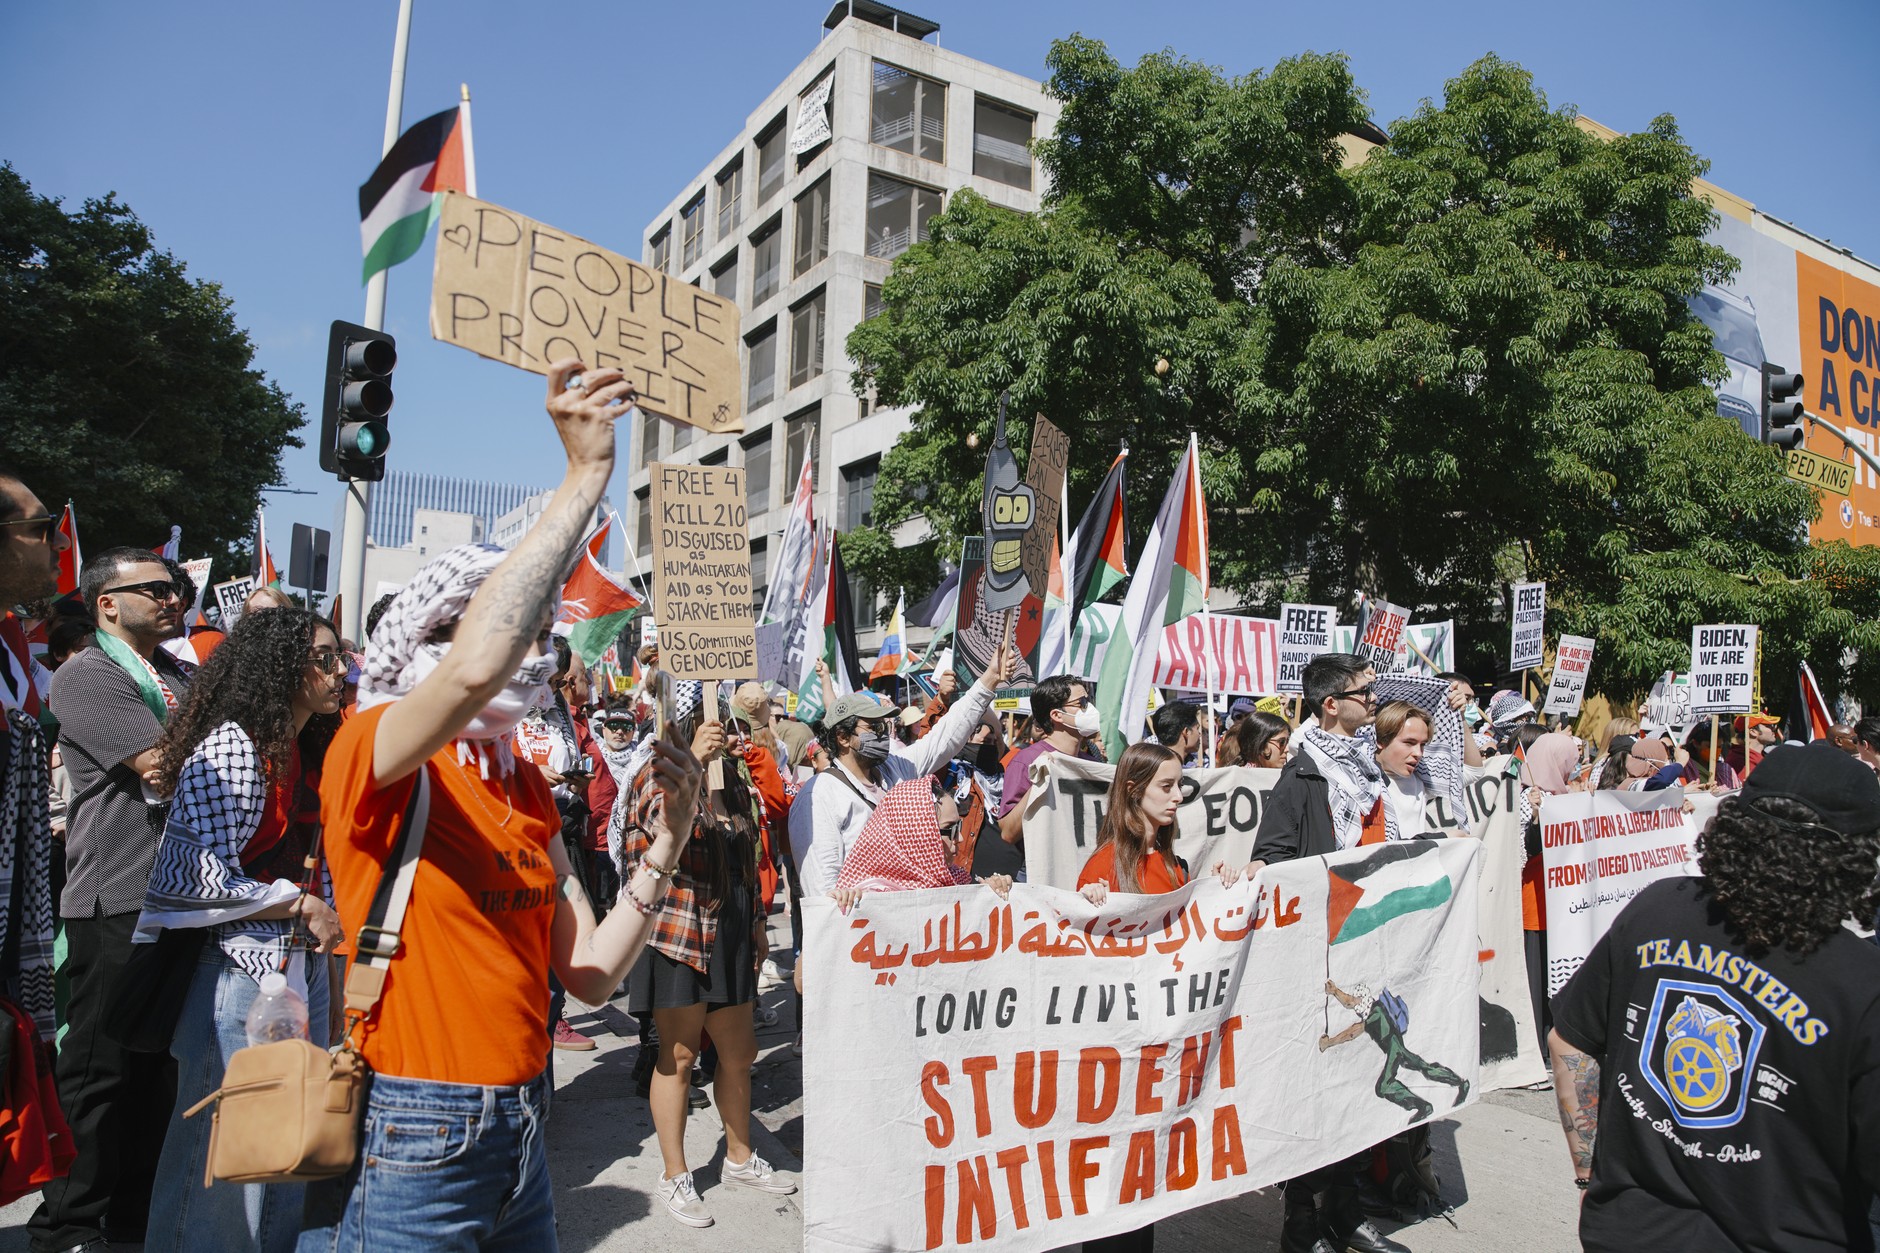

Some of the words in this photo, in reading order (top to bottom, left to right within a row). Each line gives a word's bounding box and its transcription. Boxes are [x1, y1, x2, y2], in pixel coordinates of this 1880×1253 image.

[474, 208, 725, 346] PEOPLE
[530, 285, 706, 378] OVER
[1819, 357, 1842, 417] A
[661, 468, 715, 496] FREE
[724, 472, 739, 497] 4
[1028, 457, 1049, 490] CAN
[1788, 453, 1815, 478] PED
[1818, 462, 1849, 489] XING
[663, 501, 710, 526] KILL
[714, 503, 746, 527] 210
[1035, 488, 1058, 521] BITE
[663, 528, 746, 551] DISGUISED
[689, 550, 706, 561] as
[1024, 540, 1049, 573] METAL
[664, 560, 751, 578] HUMANITARIAN
[667, 582, 691, 597] AID
[695, 583, 713, 595] as
[1028, 569, 1047, 598] ASS
[667, 601, 720, 621] STARVE
[721, 602, 753, 619] THEM
[1518, 587, 1542, 611] FREE
[1286, 608, 1328, 633] FREE
[1371, 607, 1388, 625] END
[1388, 612, 1406, 632] THE
[1515, 609, 1542, 624] PALESTINE
[661, 631, 687, 652] U.S.
[1282, 632, 1329, 646] PALESTINE
[1363, 621, 1401, 652] SIEGE
[1515, 630, 1532, 642] HANDS
[1532, 627, 1542, 639] OFF
[1699, 629, 1749, 649] BIDEN,
[1281, 651, 1309, 663] HANDS
[1358, 642, 1373, 658] ON
[1373, 647, 1395, 666] GAZA
[1514, 639, 1541, 659] RAFAH!
[1559, 645, 1568, 657] WE
[1568, 647, 1582, 659] ARE
[1582, 648, 1593, 661] THE
[1700, 651, 1718, 665] WE
[1720, 650, 1745, 665] ARE
[670, 650, 754, 673] GENOCIDE
[1695, 673, 1722, 688] YOUR
[1724, 672, 1749, 687] RED
[1706, 688, 1731, 703] LINE
[1649, 704, 1670, 726] WILL
[1544, 819, 1584, 849] UNTIL
[1583, 814, 1616, 843] RETURN
[1616, 811, 1627, 837] &
[1624, 806, 1685, 835] LIBERATION
[1547, 862, 1588, 889] FROM
[1597, 854, 1629, 879] DIEGO
[1629, 852, 1642, 873] TO
[1643, 843, 1691, 869] PALESTINE
[915, 986, 1017, 1038] LONG
[1045, 981, 1140, 1025] LIVE
[1159, 968, 1230, 1018] THE
[1636, 938, 1829, 1046] TEAMSTERS
[921, 1015, 1243, 1149] STUDENT
[1756, 1069, 1789, 1095] LOCAL
[924, 1103, 1248, 1250] INTIFADA
